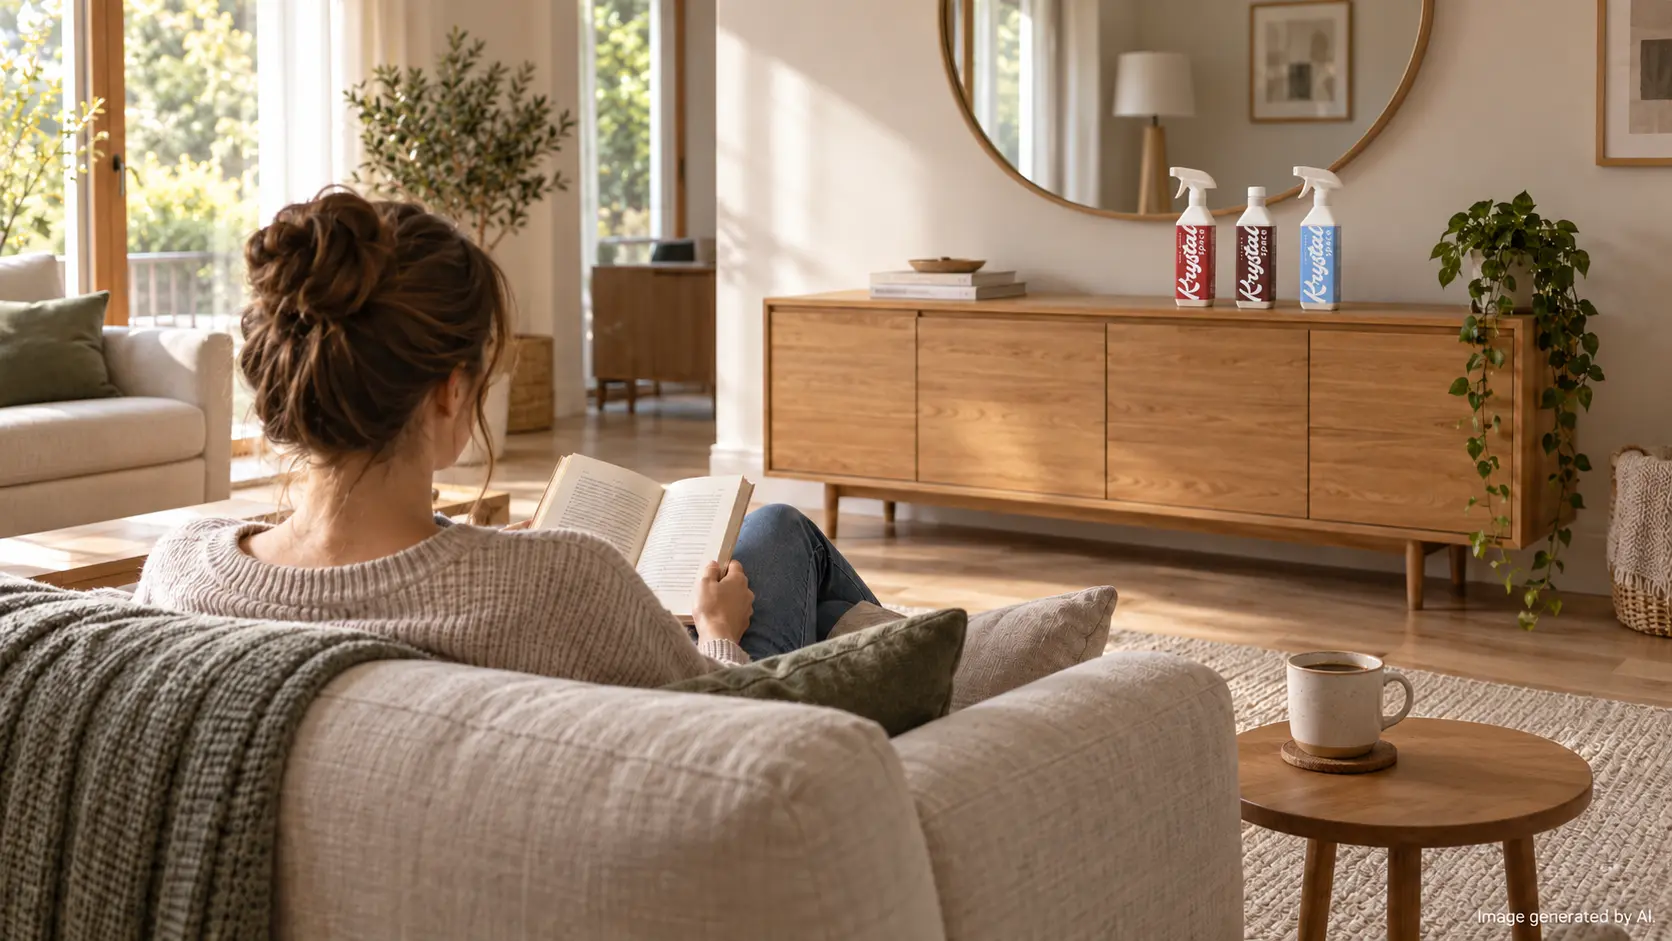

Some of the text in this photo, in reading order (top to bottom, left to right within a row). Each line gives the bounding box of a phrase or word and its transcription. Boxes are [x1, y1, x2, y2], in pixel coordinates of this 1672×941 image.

[1178, 225, 1202, 300] Krystal
[1239, 226, 1264, 302] Krystal
[1303, 226, 1329, 303] Krystal
